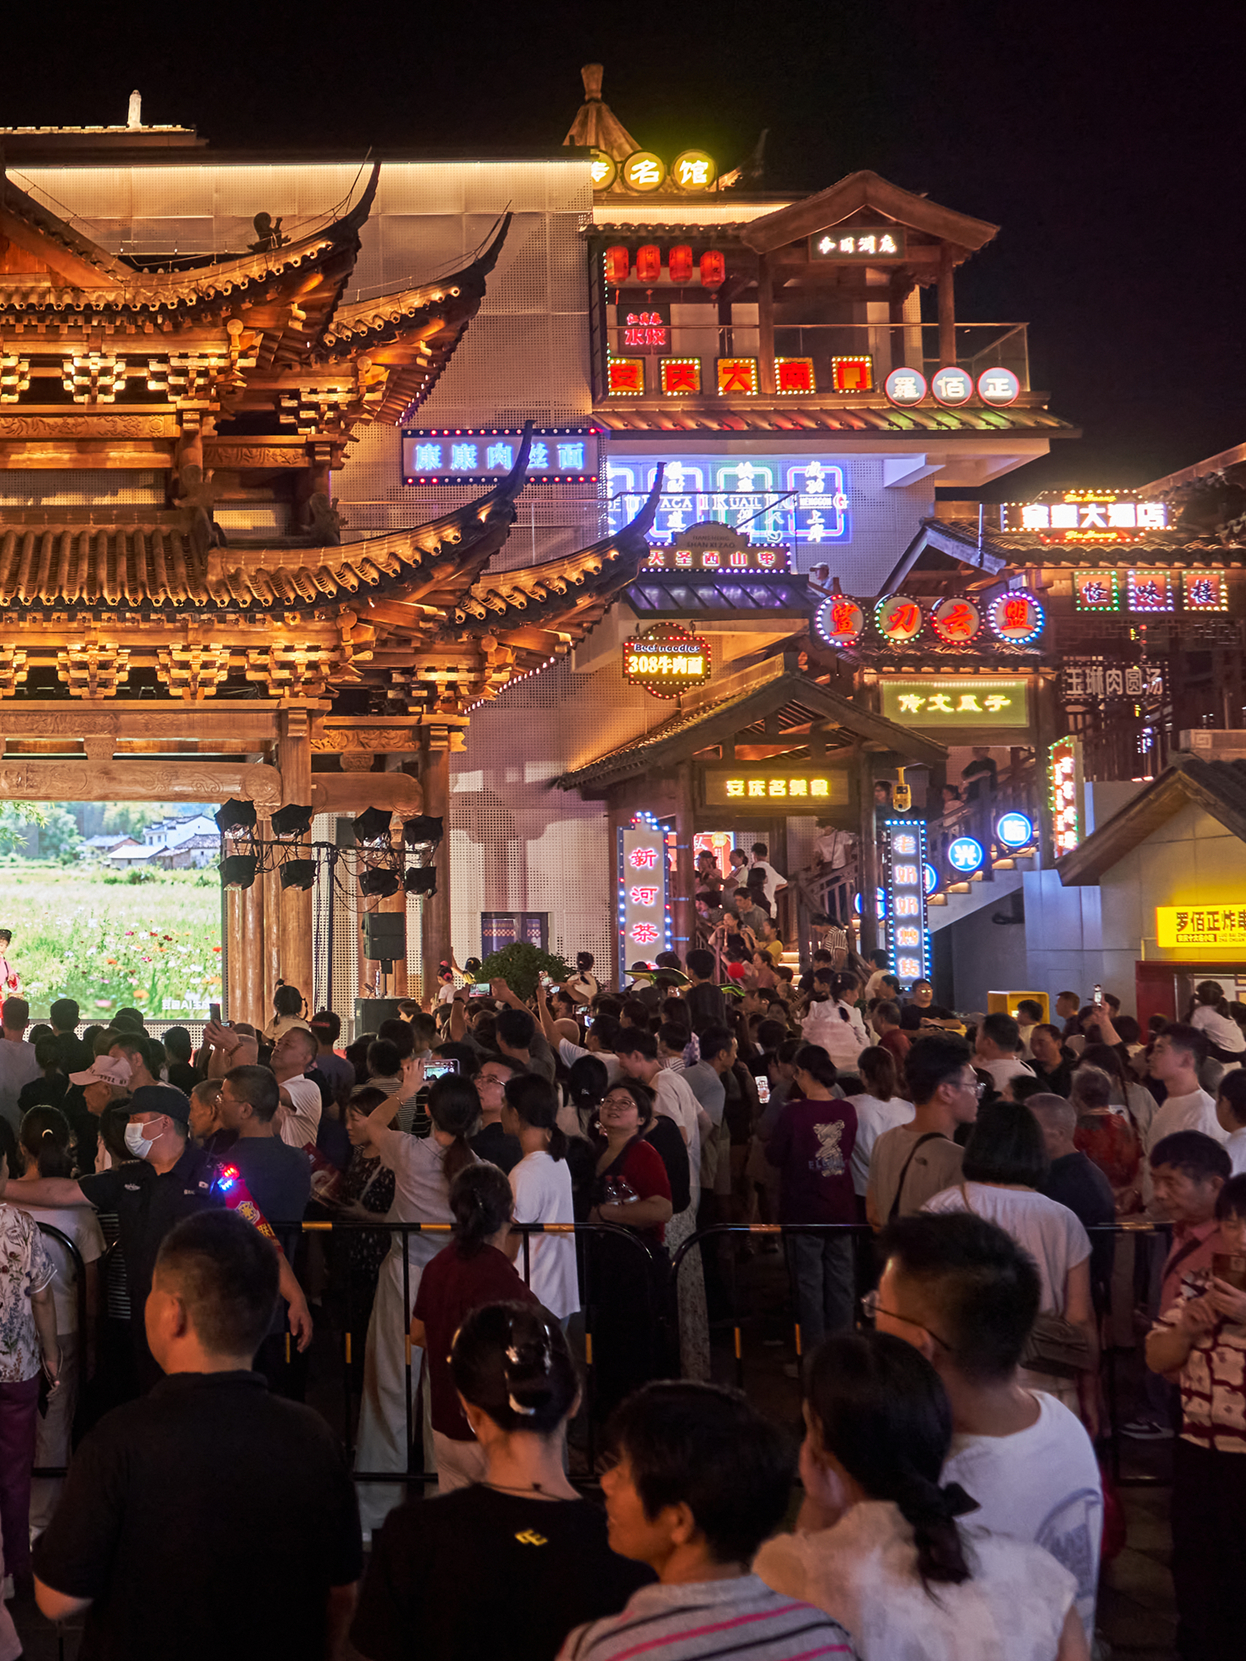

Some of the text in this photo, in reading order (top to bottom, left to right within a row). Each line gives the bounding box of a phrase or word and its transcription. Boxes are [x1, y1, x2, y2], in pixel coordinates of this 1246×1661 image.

[624, 328, 666, 346] 水饺
[609, 361, 868, 391] 安庆大南门
[647, 551, 776, 567] 天圣西山枣
[830, 599, 1035, 636] 鲨刃云盟
[634, 643, 700, 653] Beef noodles
[628, 655, 704, 675] 308牛肉面
[1065, 668, 1164, 695] 玉琳肉圆汤
[629, 847, 659, 971] 新河茶
[892, 834, 921, 978] 老奶奶炒货
